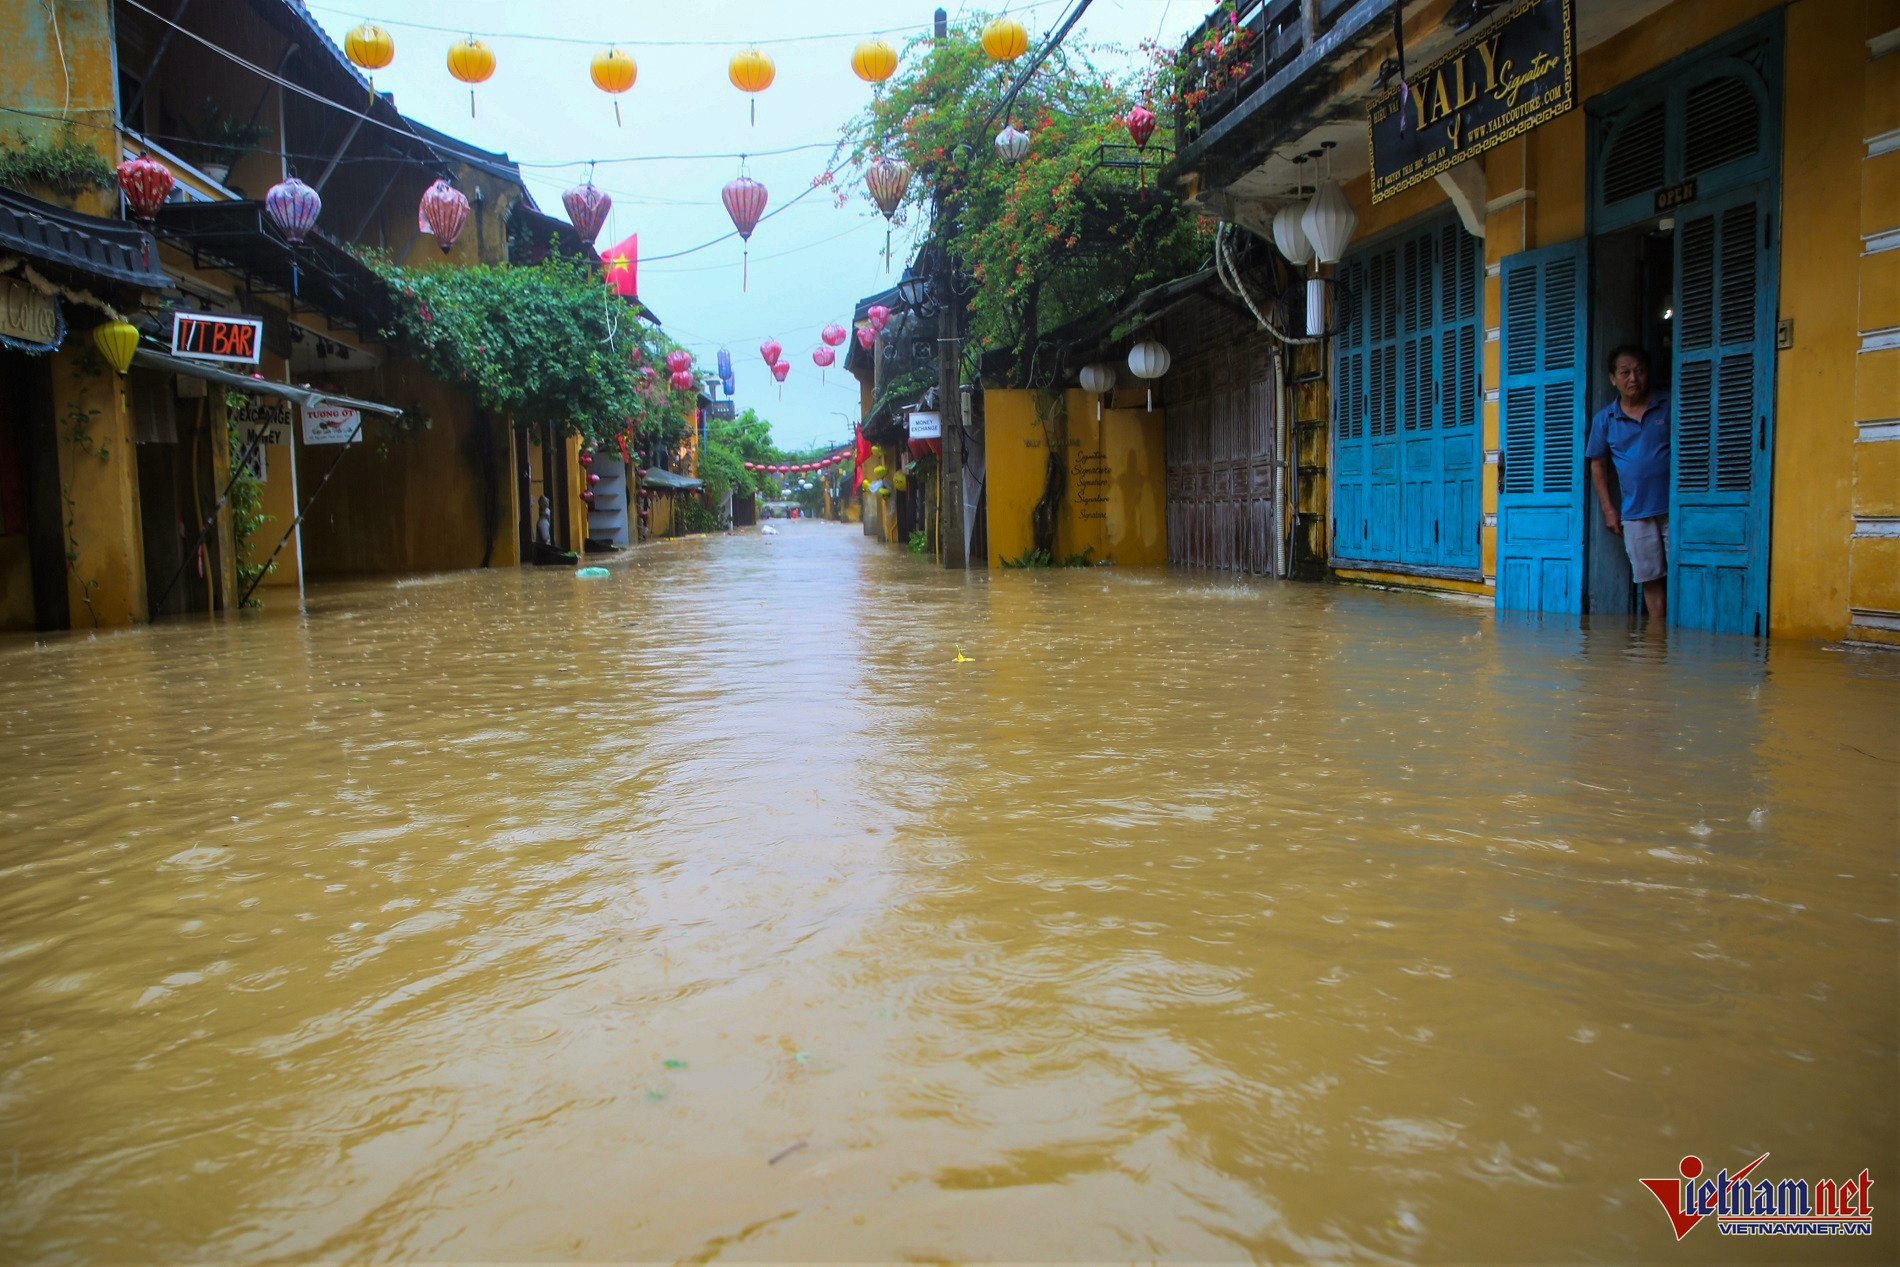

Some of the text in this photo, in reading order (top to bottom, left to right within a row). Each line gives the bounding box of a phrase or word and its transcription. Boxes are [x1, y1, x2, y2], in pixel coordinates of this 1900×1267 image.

[1408, 33, 1501, 131] YALY
[1494, 52, 1560, 107] Signature
[1658, 183, 1693, 208] OPEN
[212, 322, 252, 356] BAR
[1071, 464, 1112, 480] Signature
